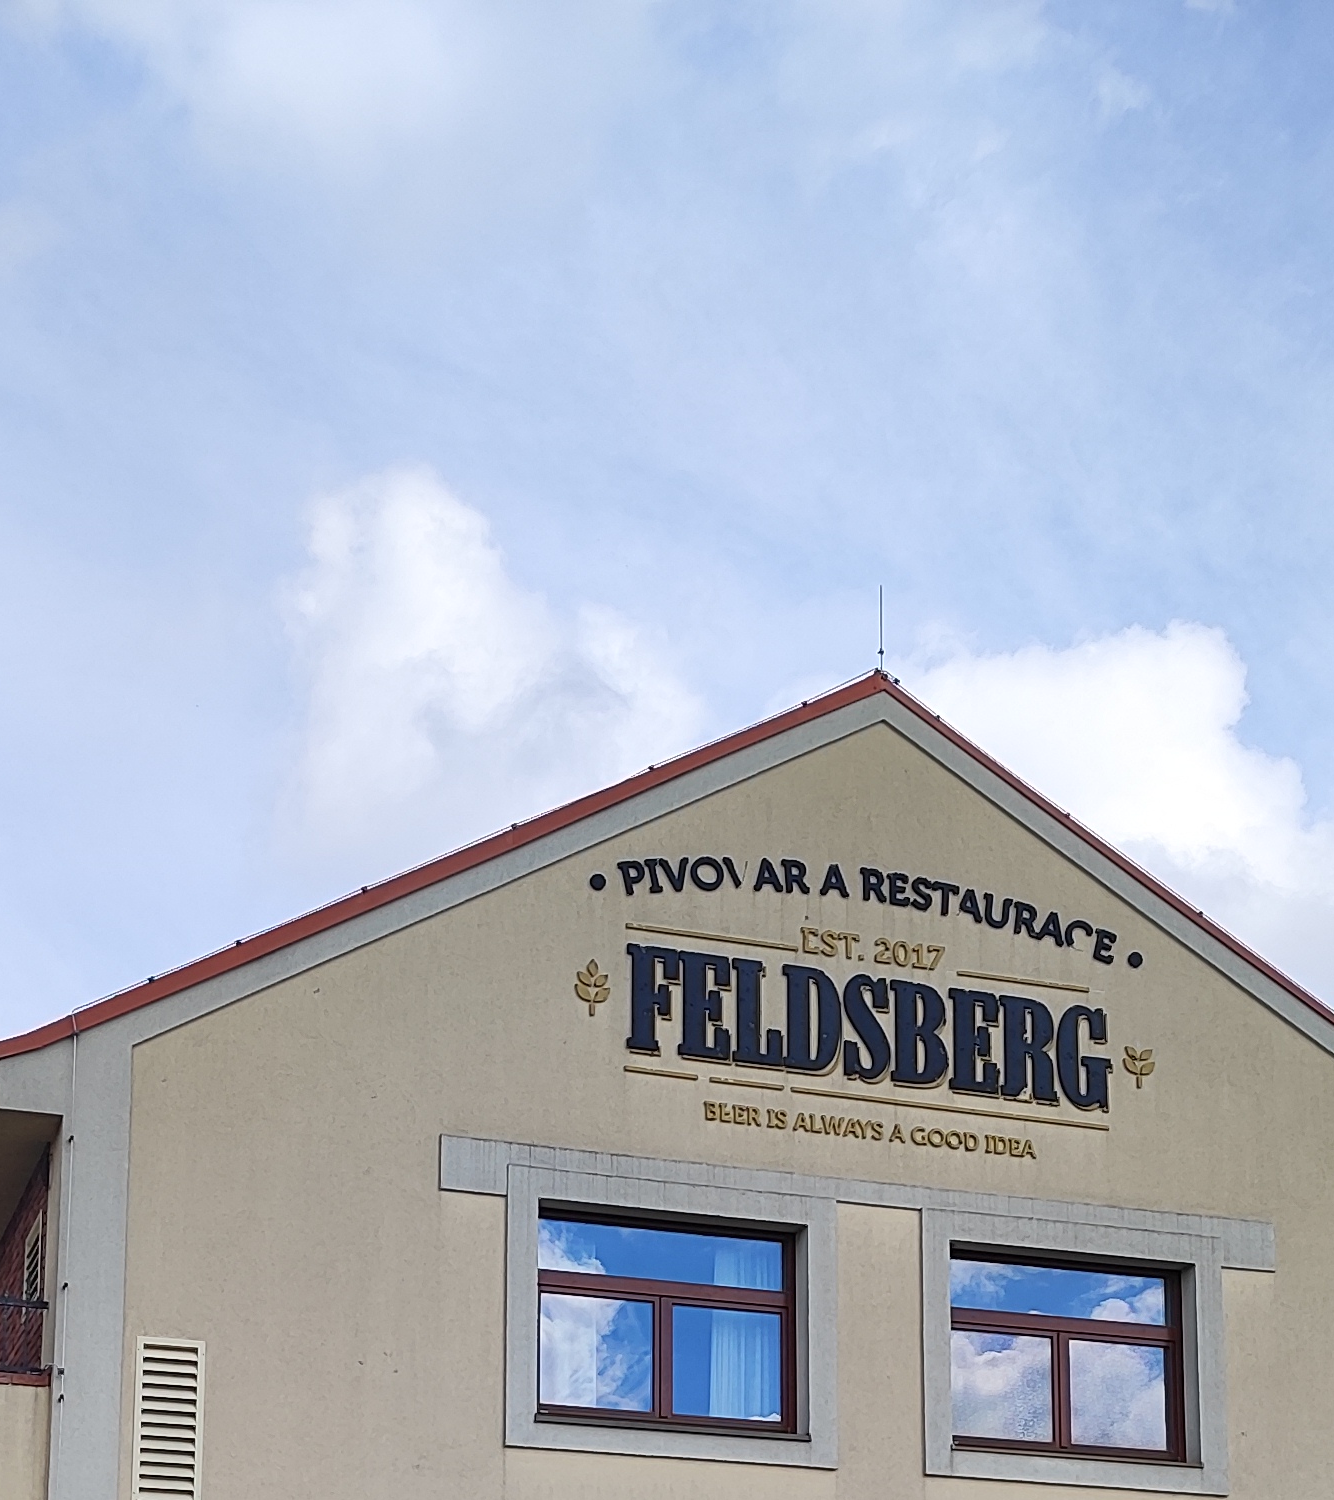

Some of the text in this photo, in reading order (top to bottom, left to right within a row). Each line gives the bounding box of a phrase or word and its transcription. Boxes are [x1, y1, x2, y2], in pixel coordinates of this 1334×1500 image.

[617, 856, 1118, 965] PIVOVAR A RESTAURACE
[800, 926, 946, 971] EST. 2017
[626, 943, 1113, 1113] FELDSBERG
[704, 1101, 1038, 1159] BEER IS ALWAYS A GOOD IDEA
